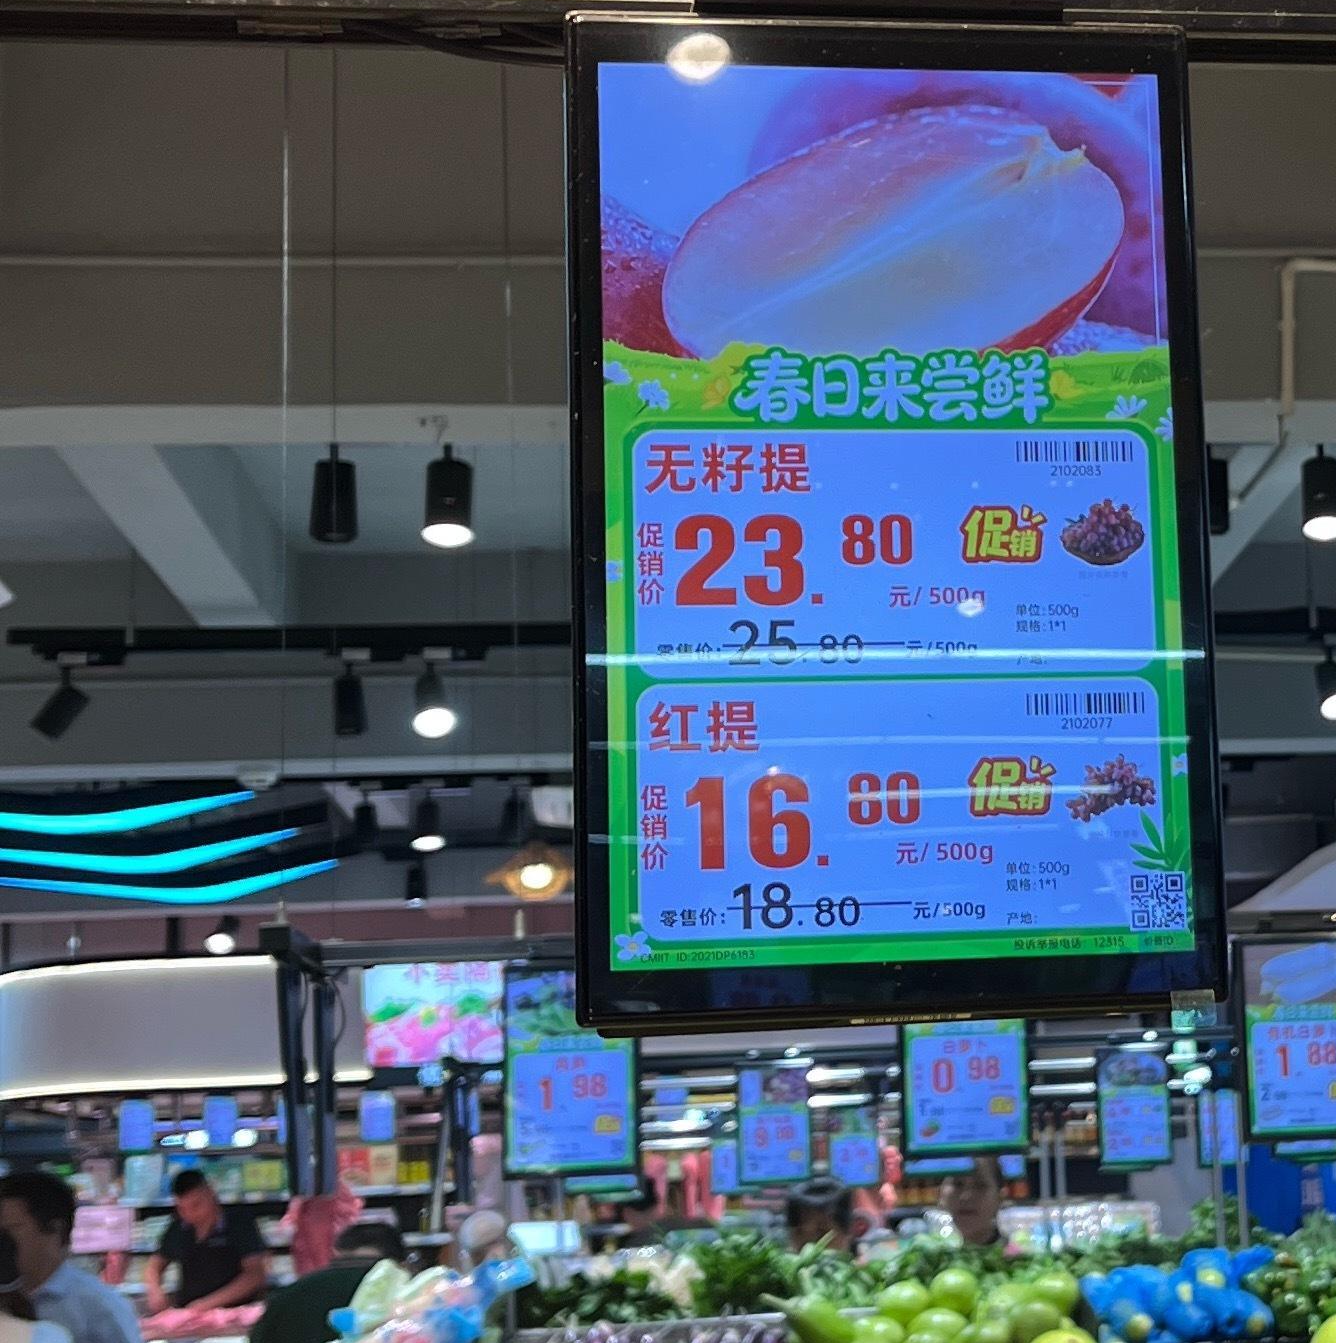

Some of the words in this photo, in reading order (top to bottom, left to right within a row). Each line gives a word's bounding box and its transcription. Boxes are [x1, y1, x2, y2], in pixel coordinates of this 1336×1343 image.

[734, 351, 1049, 423] 春日来尝鲜
[645, 443, 811, 493] 无籽提
[1050, 464, 1101, 477] 2102083
[841, 514, 913, 566] 80
[963, 509, 1037, 558] 促销
[637, 521, 665, 606] 促销价
[649, 701, 759, 752] 红提
[1061, 716, 1113, 730] 2102077
[848, 771, 921, 825] 80
[972, 759, 1050, 811] 促销
[640, 785, 669, 871] 促销价
[660, 907, 728, 928] 零售价:
[1006, 911, 1039, 925] 产地:
